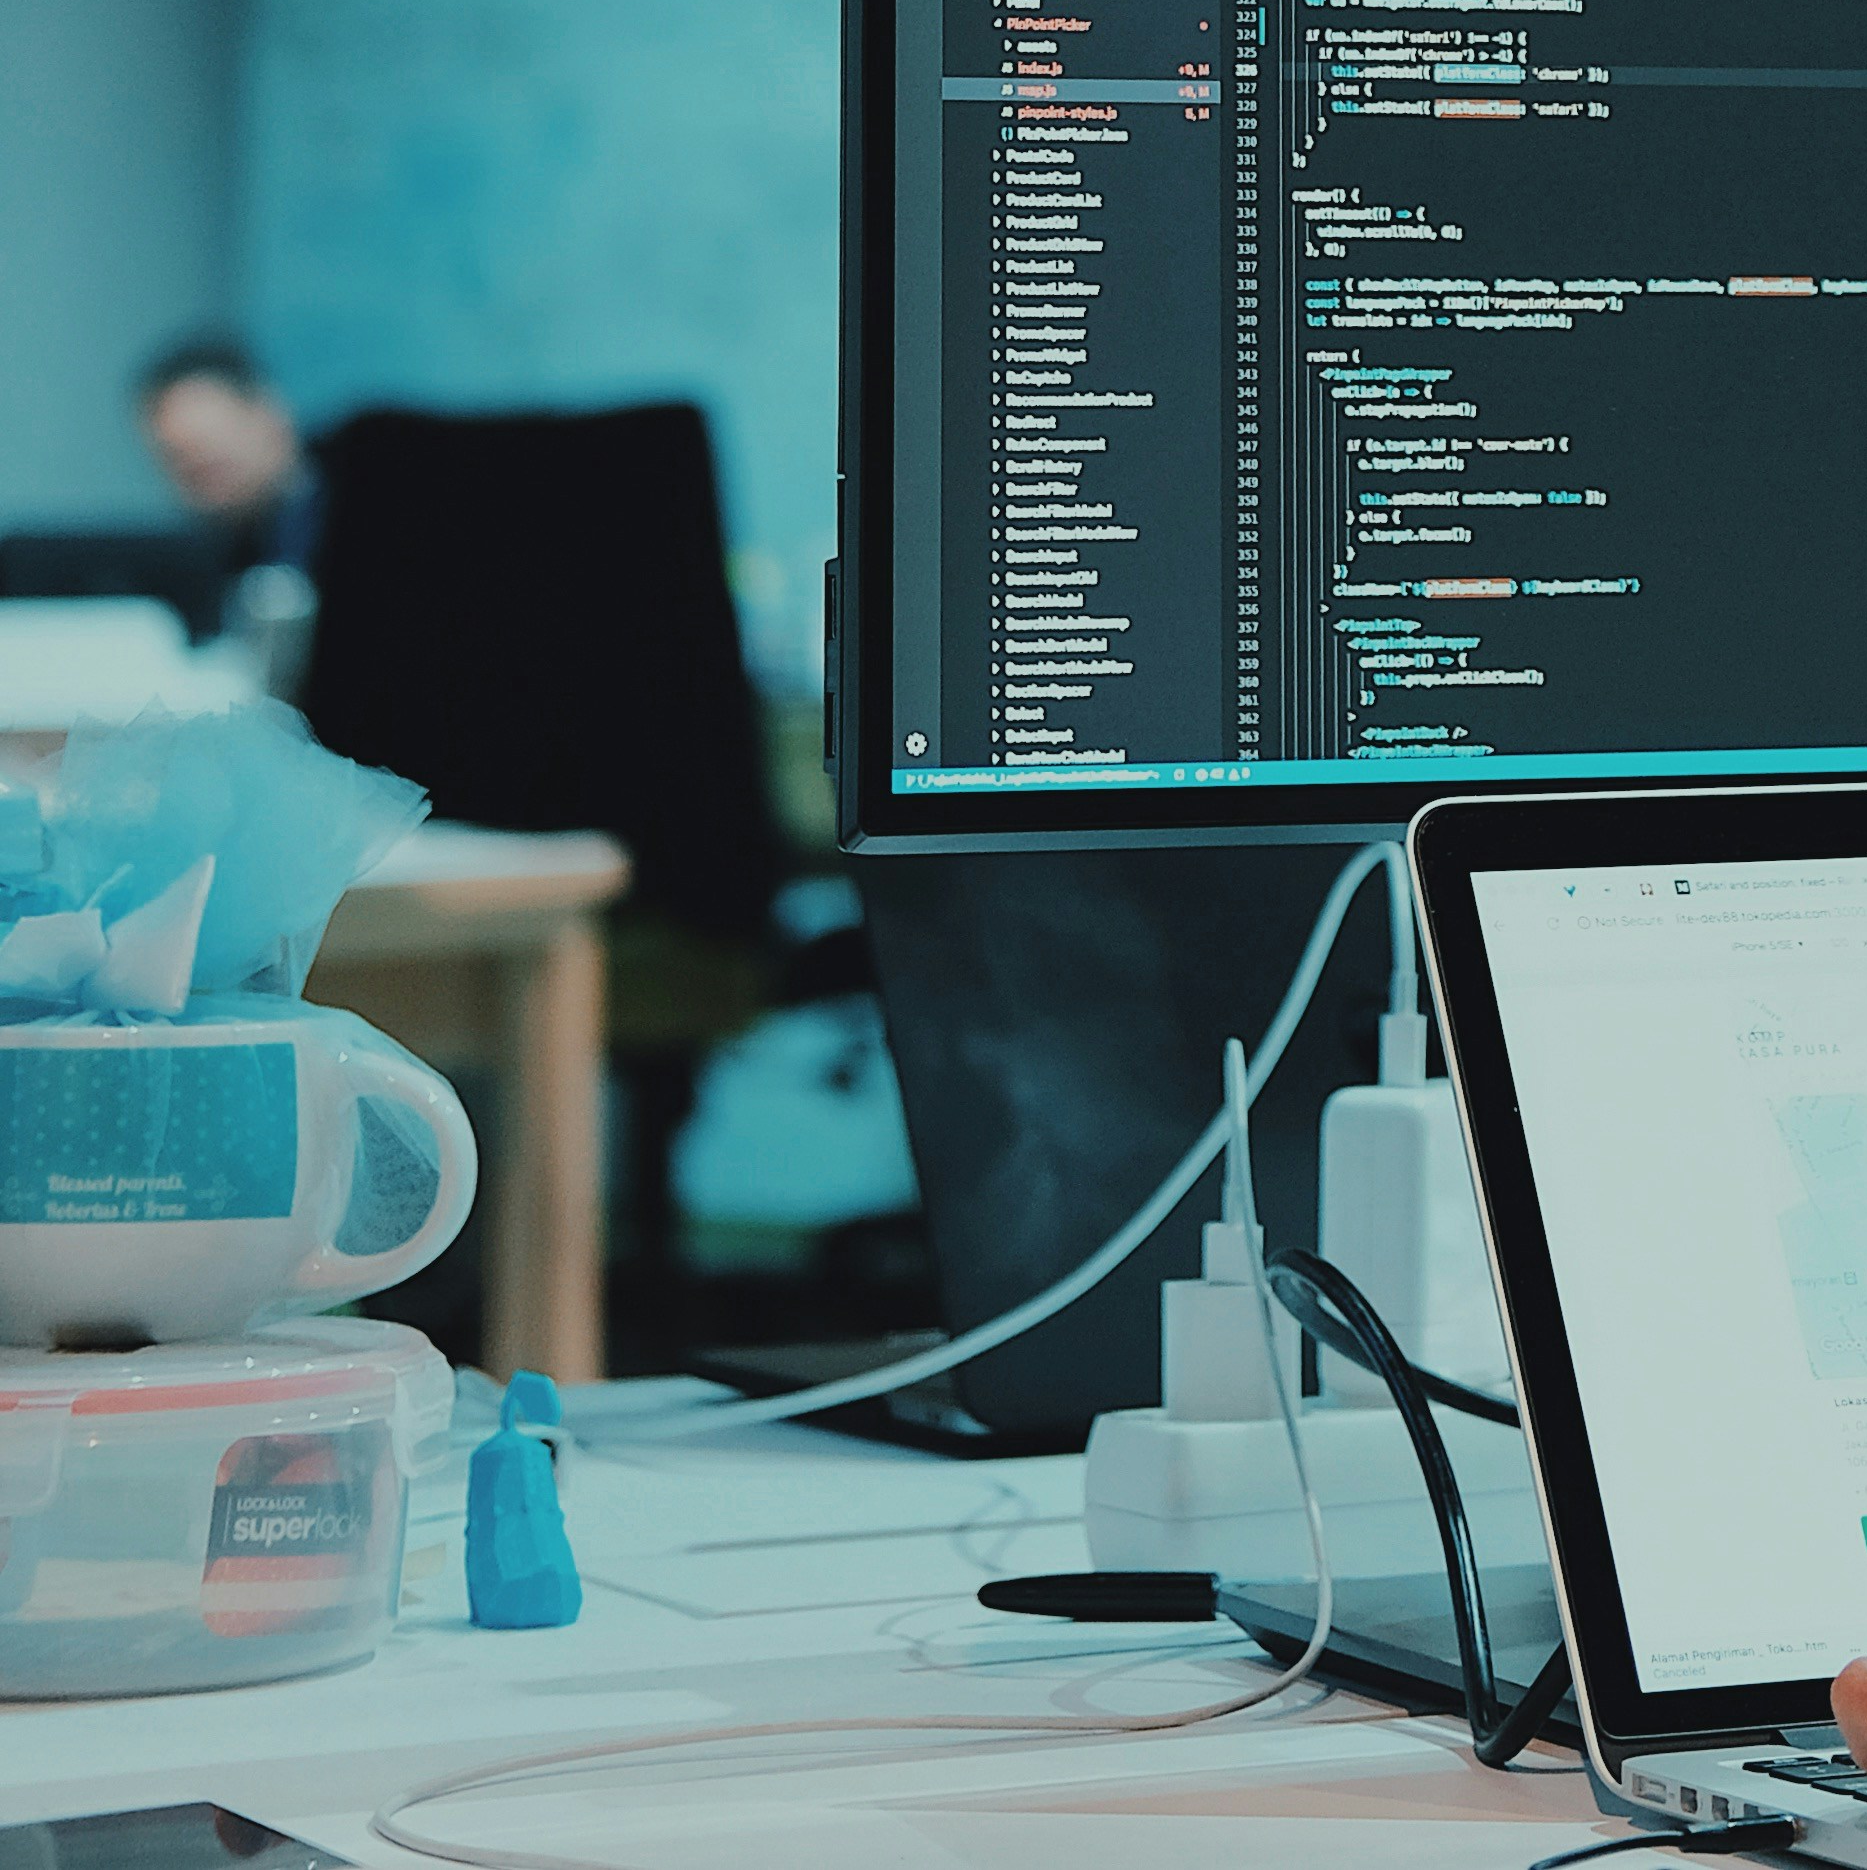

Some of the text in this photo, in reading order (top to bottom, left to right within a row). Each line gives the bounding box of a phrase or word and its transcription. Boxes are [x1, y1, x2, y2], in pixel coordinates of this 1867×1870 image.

[1007, 18, 1091, 31] PinPointPicker
[1236, 29, 1258, 42] 324
[1018, 62, 1062, 76] index.js
[1236, 99, 1257, 112] 328
[1018, 106, 1117, 121] pinpoint-styles.js
[1236, 135, 1258, 148] 330
[1236, 171, 1257, 183] 332
[1236, 207, 1257, 219] 334
[1236, 242, 1258, 255] 336
[1236, 278, 1258, 291] 338
[1305, 279, 1340, 291] const
[1237, 350, 1258, 362] 342
[1237, 386, 1258, 399] 344
[1237, 530, 1259, 543] 352
[1237, 567, 1259, 579] 354
[1238, 603, 1260, 616] 356
[1237, 712, 1260, 725] 362
[1595, 915, 1664, 928] Not Secure
[1792, 1043, 1842, 1056] PURA
[232, 1506, 362, 1550] superlock
[1651, 1647, 1756, 1664] Alamat Pengiriman
[1652, 1665, 1708, 1680] Canceled
